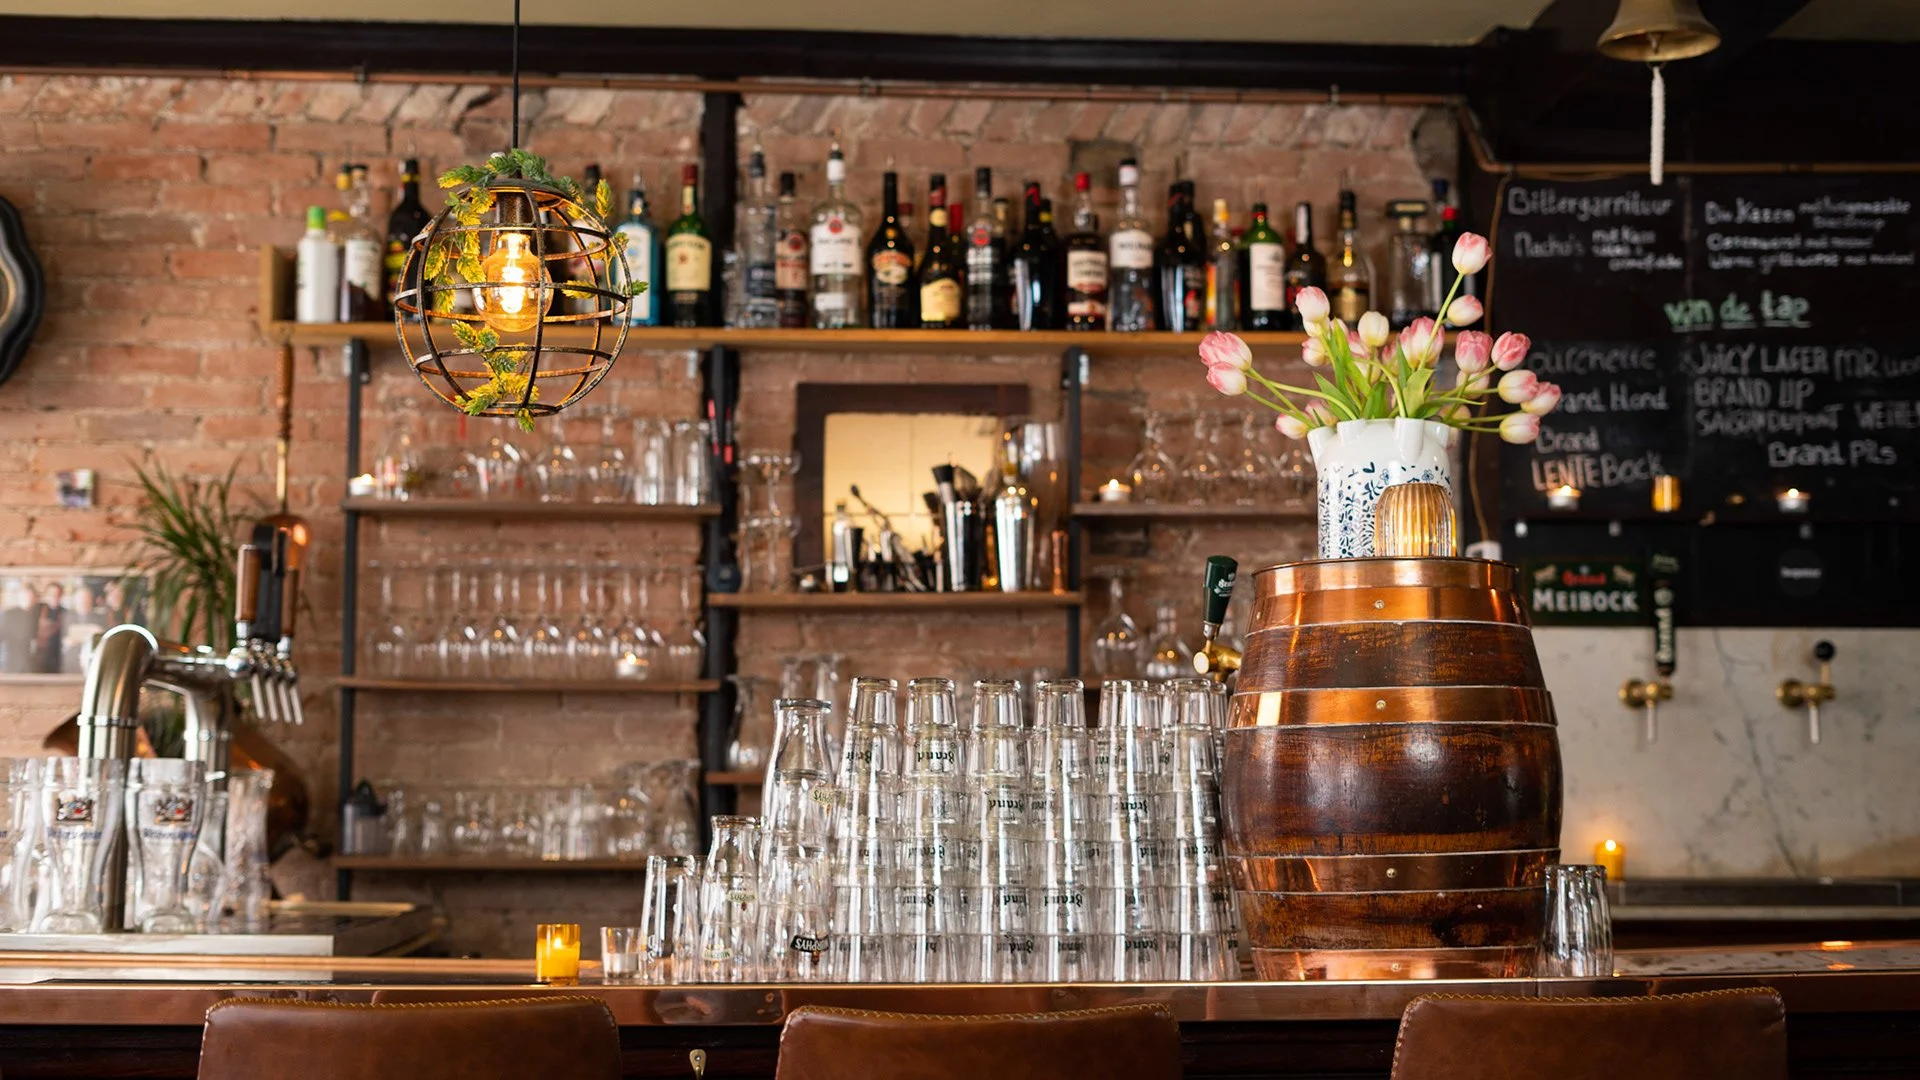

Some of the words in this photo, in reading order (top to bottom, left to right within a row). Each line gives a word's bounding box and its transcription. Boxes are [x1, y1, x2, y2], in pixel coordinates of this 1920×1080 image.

[1768, 440, 1846, 468] Brand
[1532, 589, 1639, 613] MEIBOCK
[917, 750, 955, 764] Brand
